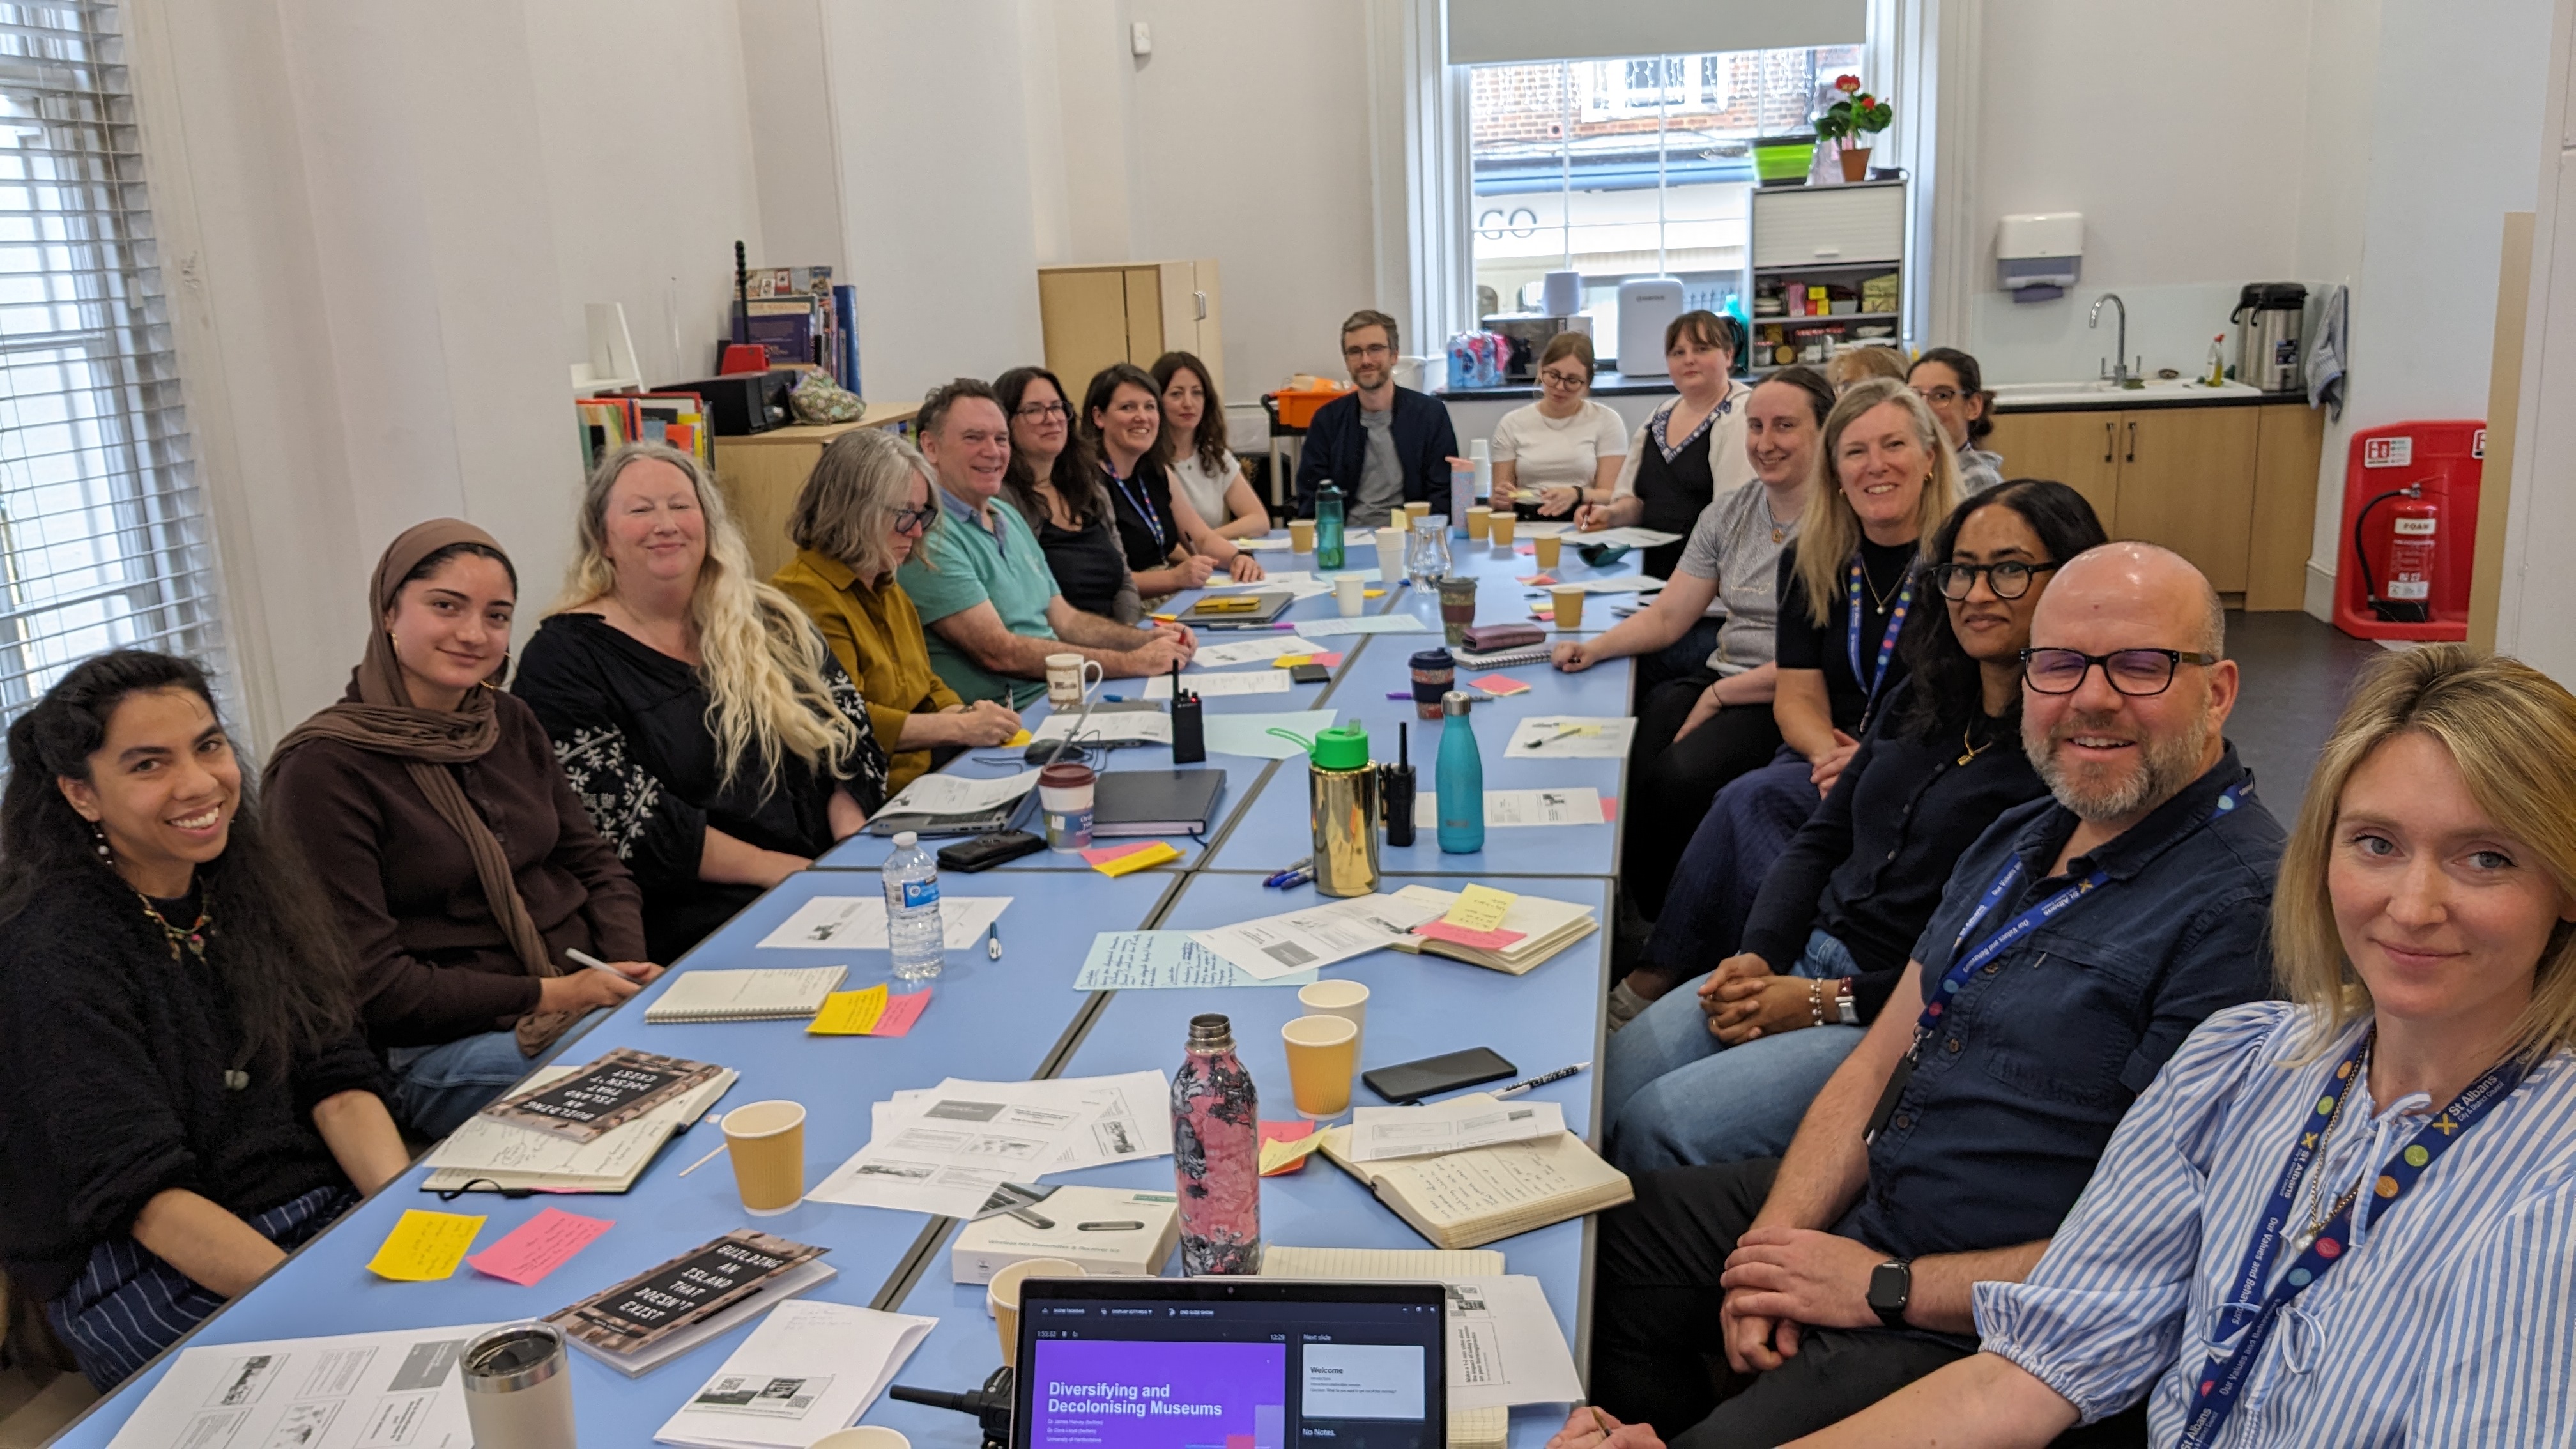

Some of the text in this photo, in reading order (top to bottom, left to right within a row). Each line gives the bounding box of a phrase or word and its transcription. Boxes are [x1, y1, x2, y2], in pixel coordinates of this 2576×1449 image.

[2017, 919, 2030, 930] Our
[1998, 927, 2019, 943] Values
[1988, 939, 2000, 952] and
[588, 1075, 652, 1091] DOESN'T
[611, 1069, 659, 1084] EXIST
[564, 1089, 618, 1105] ISLAND
[585, 1084, 624, 1097] THAT
[2448, 1075, 2499, 1116] St Albans
[563, 1100, 588, 1108] AN
[2457, 1110, 2470, 1122] City
[2471, 1096, 2488, 1110] District
[2485, 1080, 2505, 1098] Council
[523, 1101, 595, 1121] BUILDING
[2284, 1162, 2303, 1199] Albans
[716, 1245, 784, 1269] BUILDING
[716, 1262, 742, 1275] AN
[2232, 1216, 2279, 1325] Our Values and Behavours
[680, 1267, 734, 1289] ISLAND
[668, 1280, 707, 1298] THAT
[634, 1287, 695, 1311] DOESN'T
[618, 1300, 666, 1321] EXIST
[2219, 1382, 2234, 1395] Our
[2228, 1355, 2248, 1381] Values
[2244, 1339, 2256, 1355] and
[1049, 1381, 1170, 1399] Diversifying and
[1048, 1398, 1222, 1417] Decolonising Museums
[1302, 1428, 1336, 1437] No Notes.
[2186, 1407, 2212, 1440] Albans
